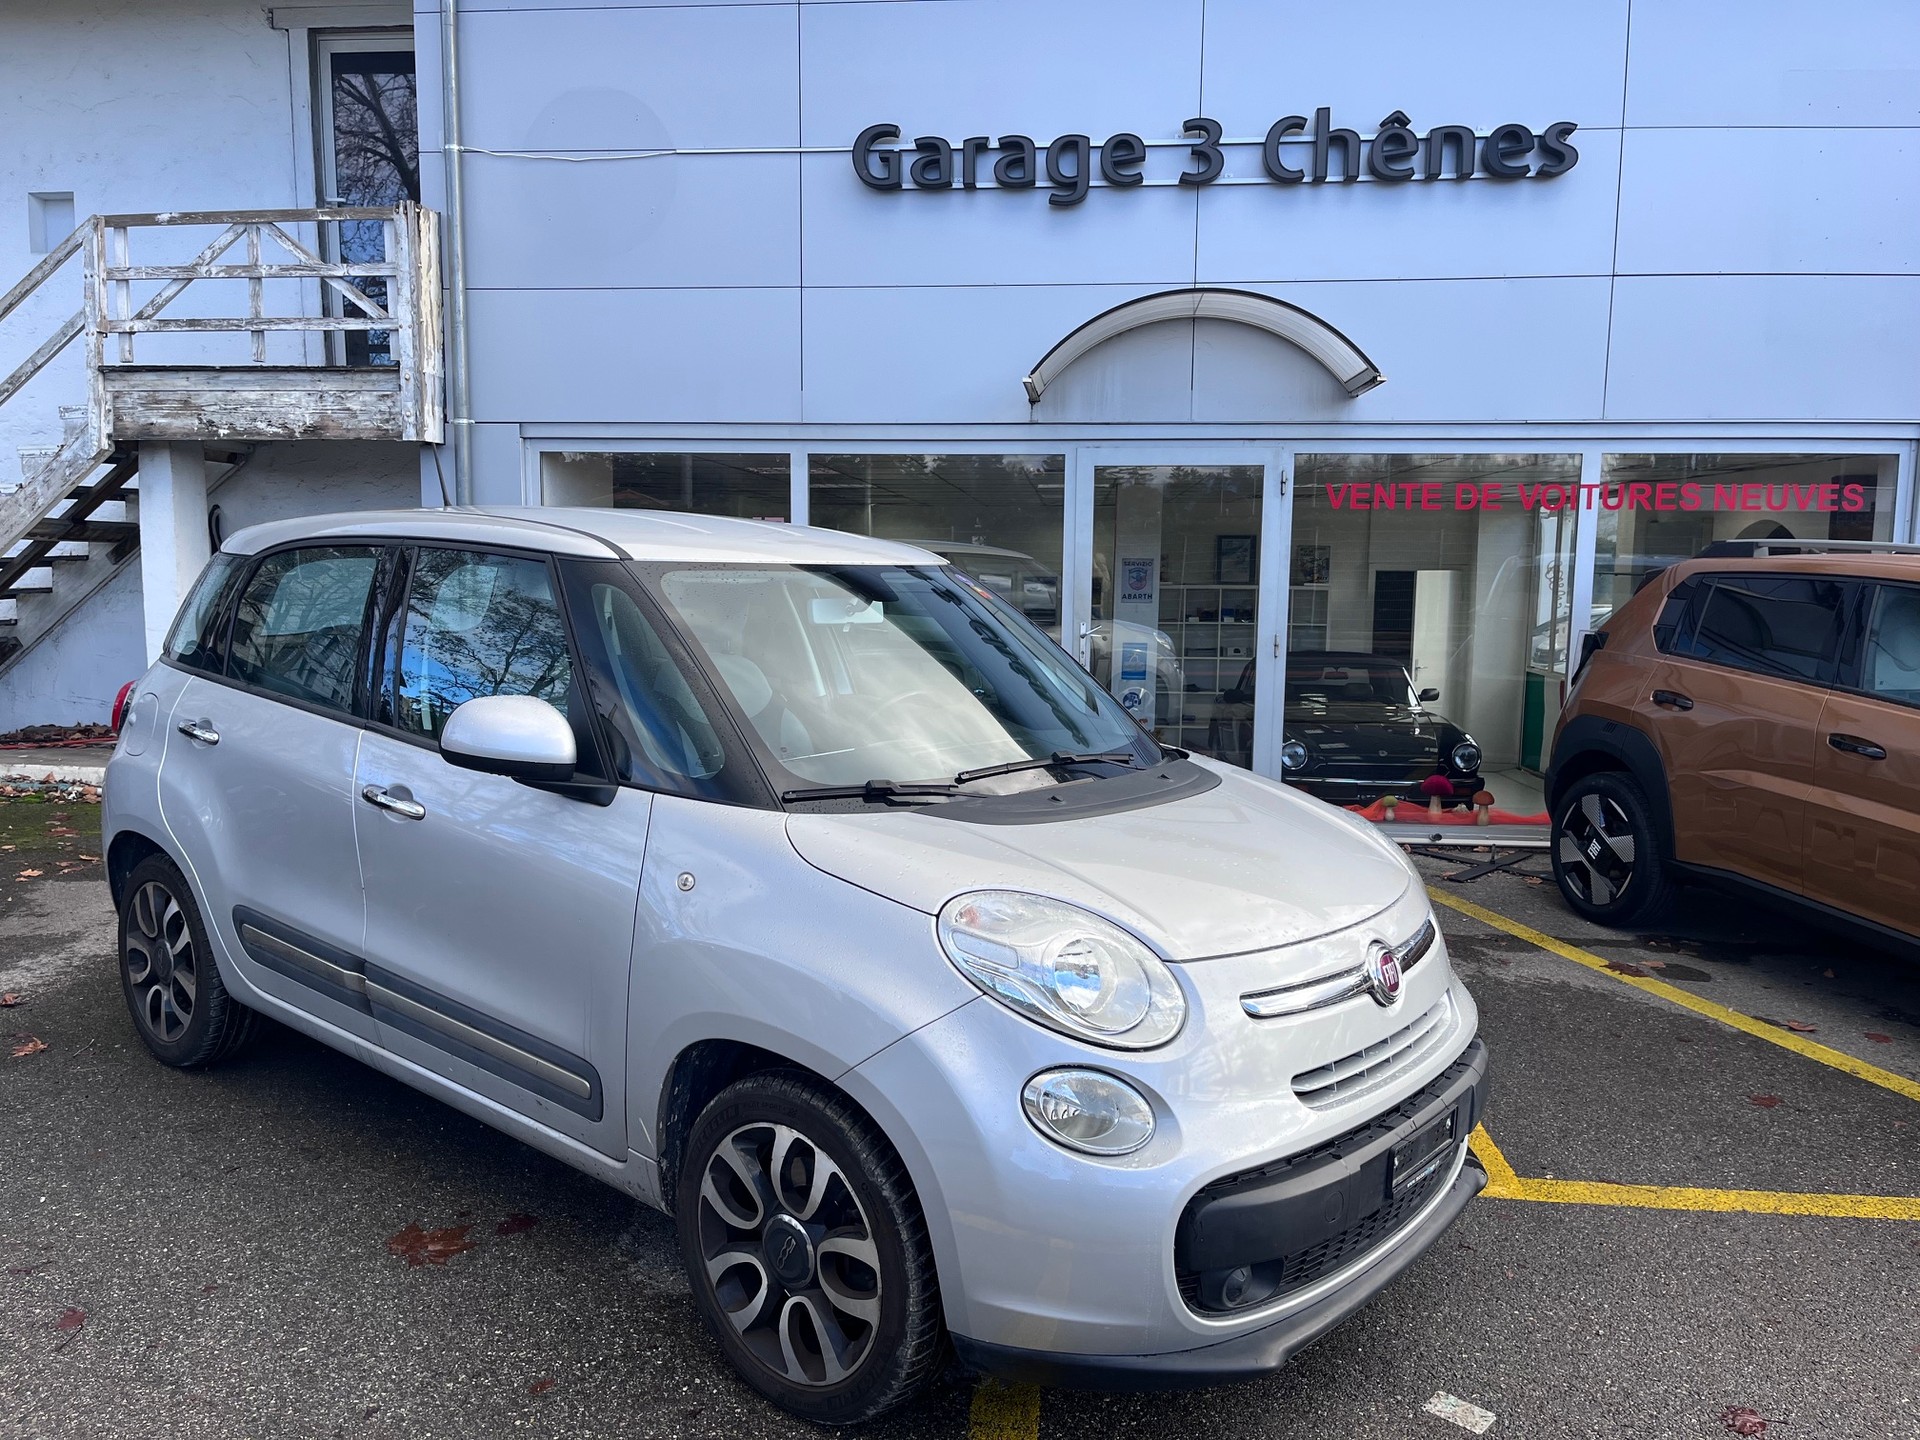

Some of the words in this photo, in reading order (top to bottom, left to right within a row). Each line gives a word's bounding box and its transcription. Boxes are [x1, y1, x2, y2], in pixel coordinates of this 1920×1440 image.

[852, 123, 1147, 207] Garage
[1178, 116, 1226, 186] 3
[1262, 106, 1579, 184] Chênes
[1325, 482, 1443, 511] VENTE
[1454, 482, 1504, 511] DE
[1517, 482, 1703, 512] VOITURES
[1713, 483, 1865, 513] NEUVES
